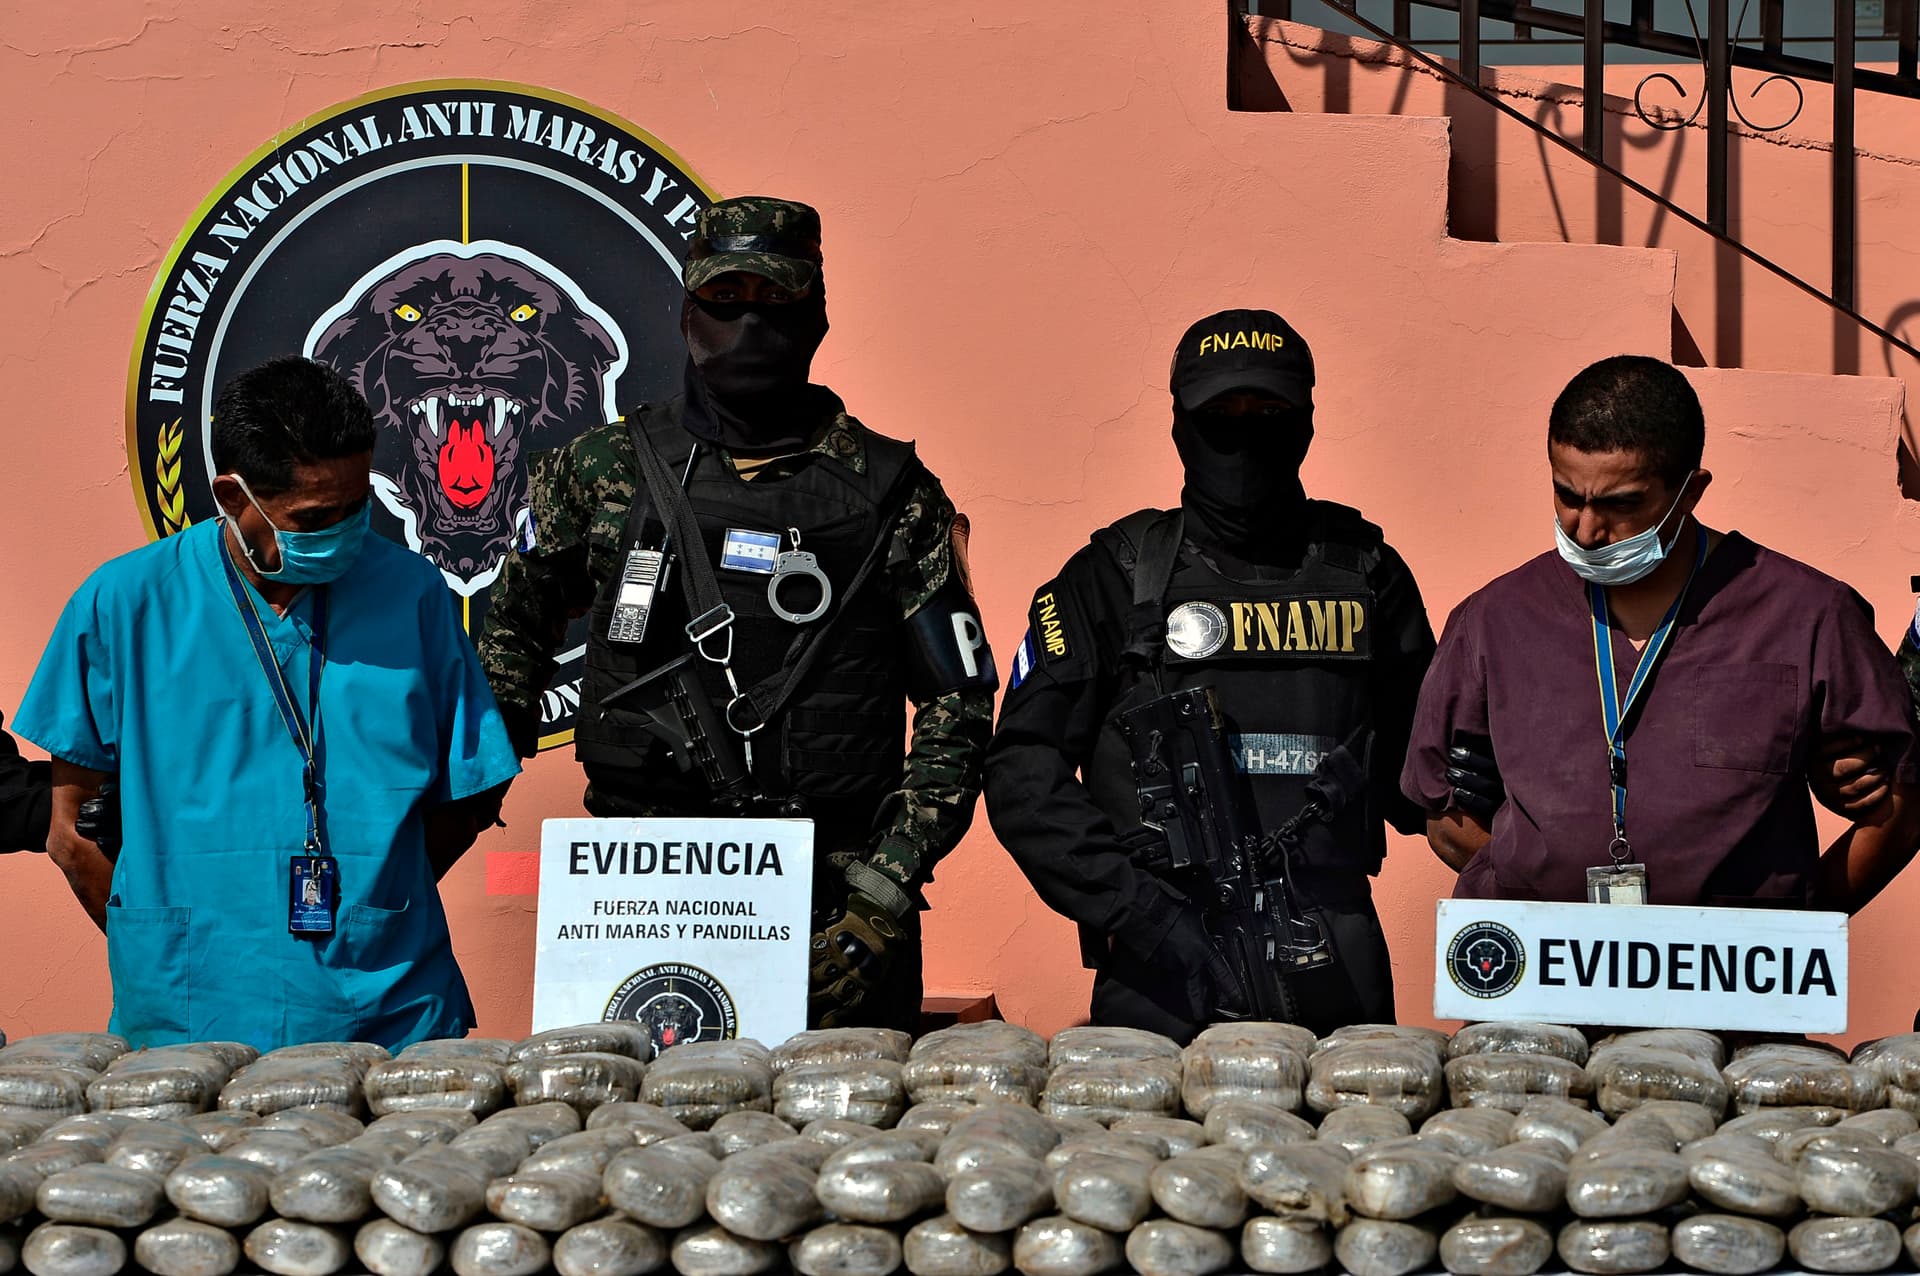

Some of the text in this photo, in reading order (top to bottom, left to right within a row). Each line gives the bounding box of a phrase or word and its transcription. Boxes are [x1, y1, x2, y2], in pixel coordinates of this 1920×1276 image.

[149, 250, 228, 404] FUERZA
[208, 114, 394, 253] NACIONAL
[397, 101, 496, 142] ANTI
[503, 104, 646, 186] MARAS
[639, 165, 679, 206] Y
[1199, 330, 1284, 356] FNAMP
[950, 611, 983, 678] P
[1036, 592, 1066, 658] FNAMP
[1230, 600, 1364, 652] FNAMP
[568, 842, 784, 876] EVIDENCIA
[593, 900, 757, 916] FUERZA NACIONAL
[557, 924, 791, 941] ANTI MARAS Y PANDILLAS
[658, 965, 678, 975] ANTI
[1538, 938, 1837, 996] EVIDENCIA
